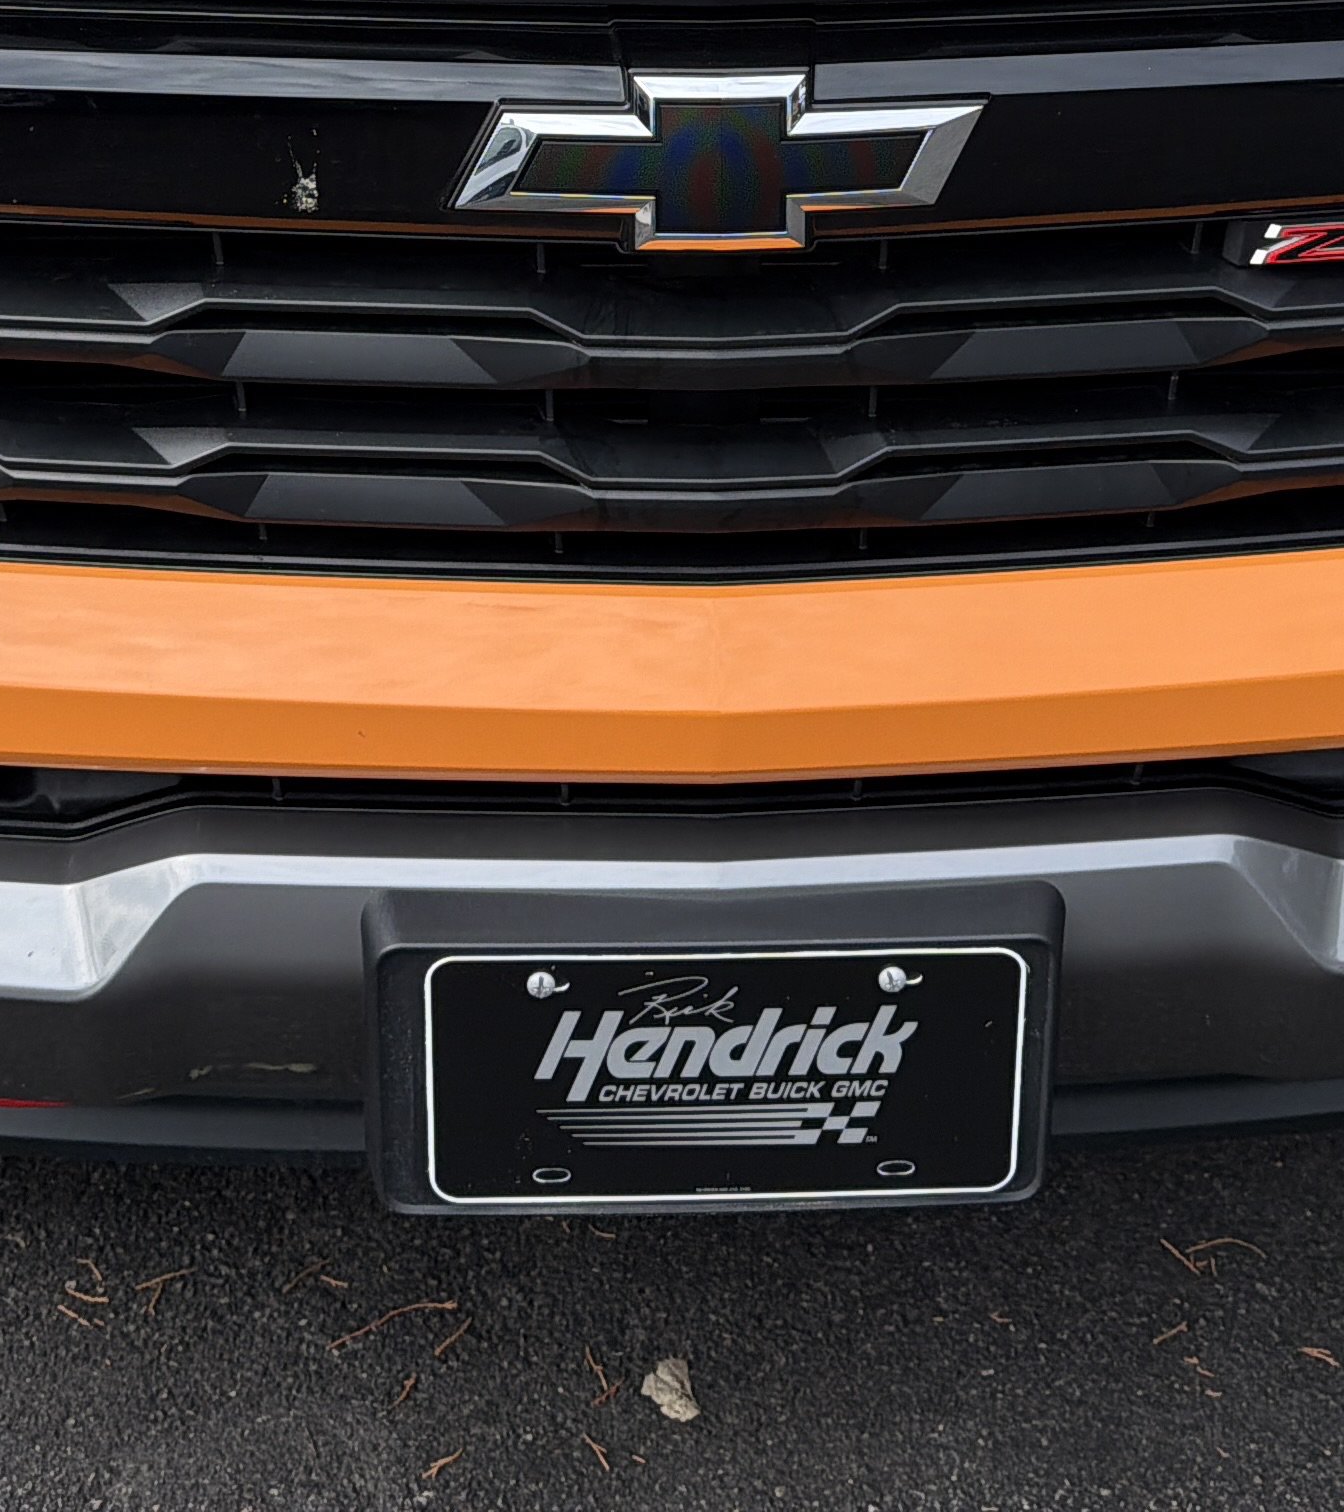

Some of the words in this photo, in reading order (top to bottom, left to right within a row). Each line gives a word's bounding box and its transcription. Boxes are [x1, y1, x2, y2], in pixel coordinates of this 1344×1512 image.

[533, 1004, 919, 1103] Hendrick
[598, 1083, 745, 1103] CHEVROLET
[748, 1080, 822, 1101] BUICK
[830, 1079, 889, 1099] GMC
